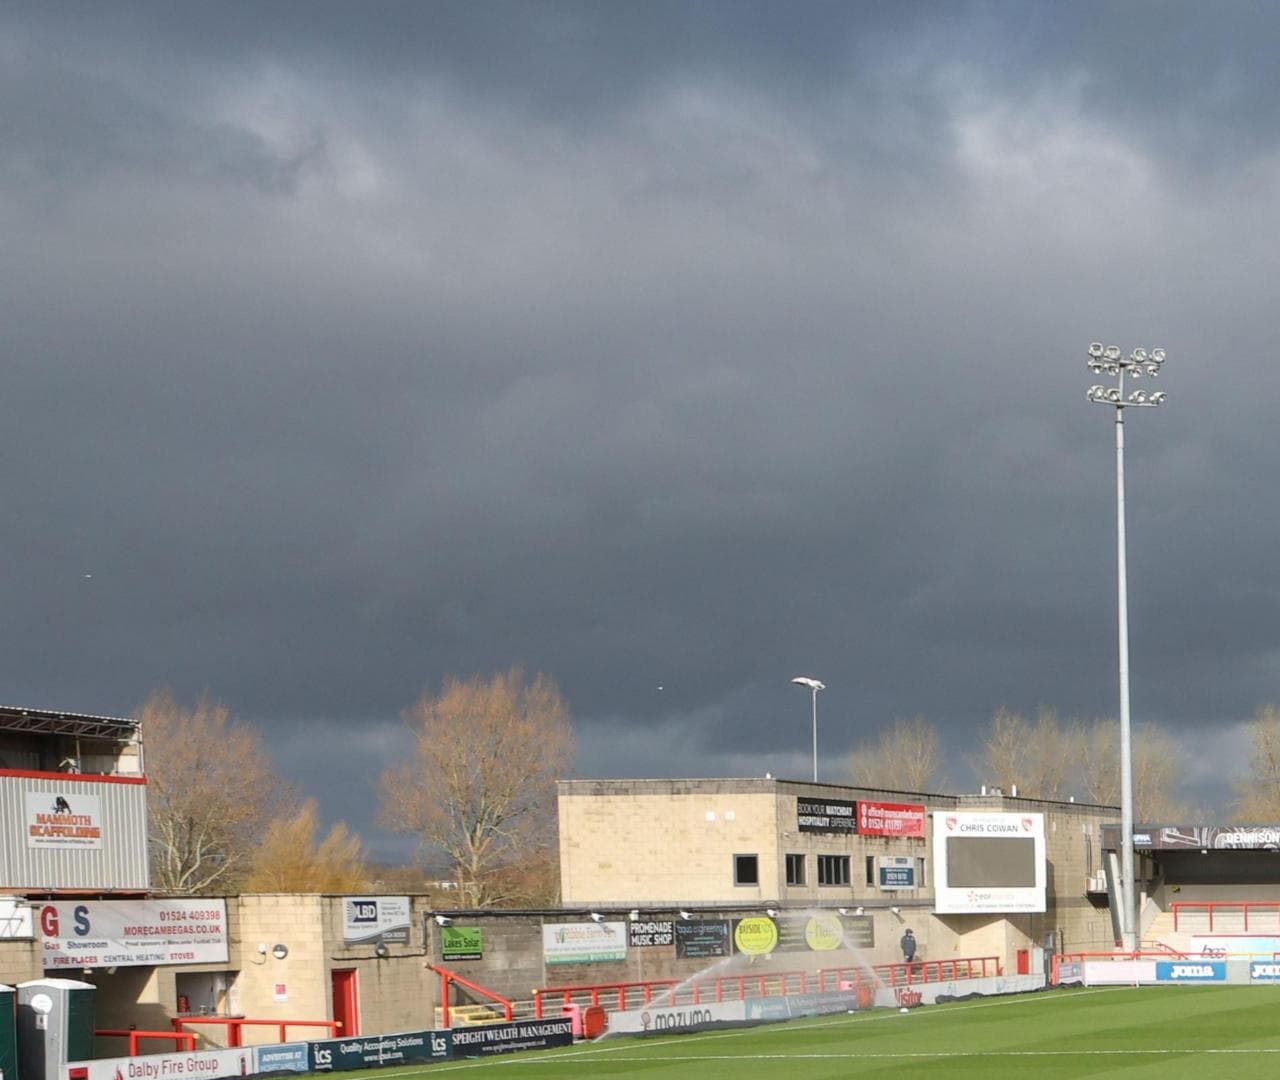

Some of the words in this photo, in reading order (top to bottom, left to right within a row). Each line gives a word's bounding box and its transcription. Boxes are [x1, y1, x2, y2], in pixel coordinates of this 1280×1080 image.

[826, 805, 852, 815] MATCHDAY
[36, 813, 92, 825] MAMMOTH
[799, 816, 830, 826] HOSPITALITY
[29, 825, 100, 838] SCAFFOLDING
[960, 824, 984, 833] CHRIS
[987, 824, 1018, 833] COWAN
[159, 911, 186, 921] 01524
[356, 904, 376, 918] LBD
[41, 905, 59, 937] G
[73, 905, 90, 936] S
[123, 925, 221, 937] MORECAMBEGAS.CO.UK
[630, 922, 673, 933] PROMENADE
[44, 942, 60, 951] Gas
[67, 940, 108, 950] Showroom
[444, 938, 462, 948] Lakes
[463, 937, 479, 948] Solar
[631, 935, 652, 946] MUSIC
[654, 934, 673, 945] SHOP
[53, 956, 70, 965] FIRE
[71, 955, 97, 964] PLACES
[103, 954, 134, 963] CENTRAL
[136, 953, 164, 962] HEATING
[170, 952, 195, 961] STOVES
[894, 987, 922, 1005] Visitor
[655, 1009, 712, 1031] mazuma
[452, 1031, 487, 1045] SPEIGHT
[488, 1028, 518, 1042] WEALTH
[519, 1023, 573, 1039] MANAGEMENT
[340, 1041, 362, 1055] Quality
[363, 1039, 397, 1053] Accounting
[397, 1037, 423, 1049] Solutions
[262, 1052, 292, 1062] ADVERTISE
[293, 1051, 303, 1060] AT
[128, 1062, 160, 1078] Dalby
[162, 1060, 184, 1075] Fire
[187, 1057, 219, 1074] Group
